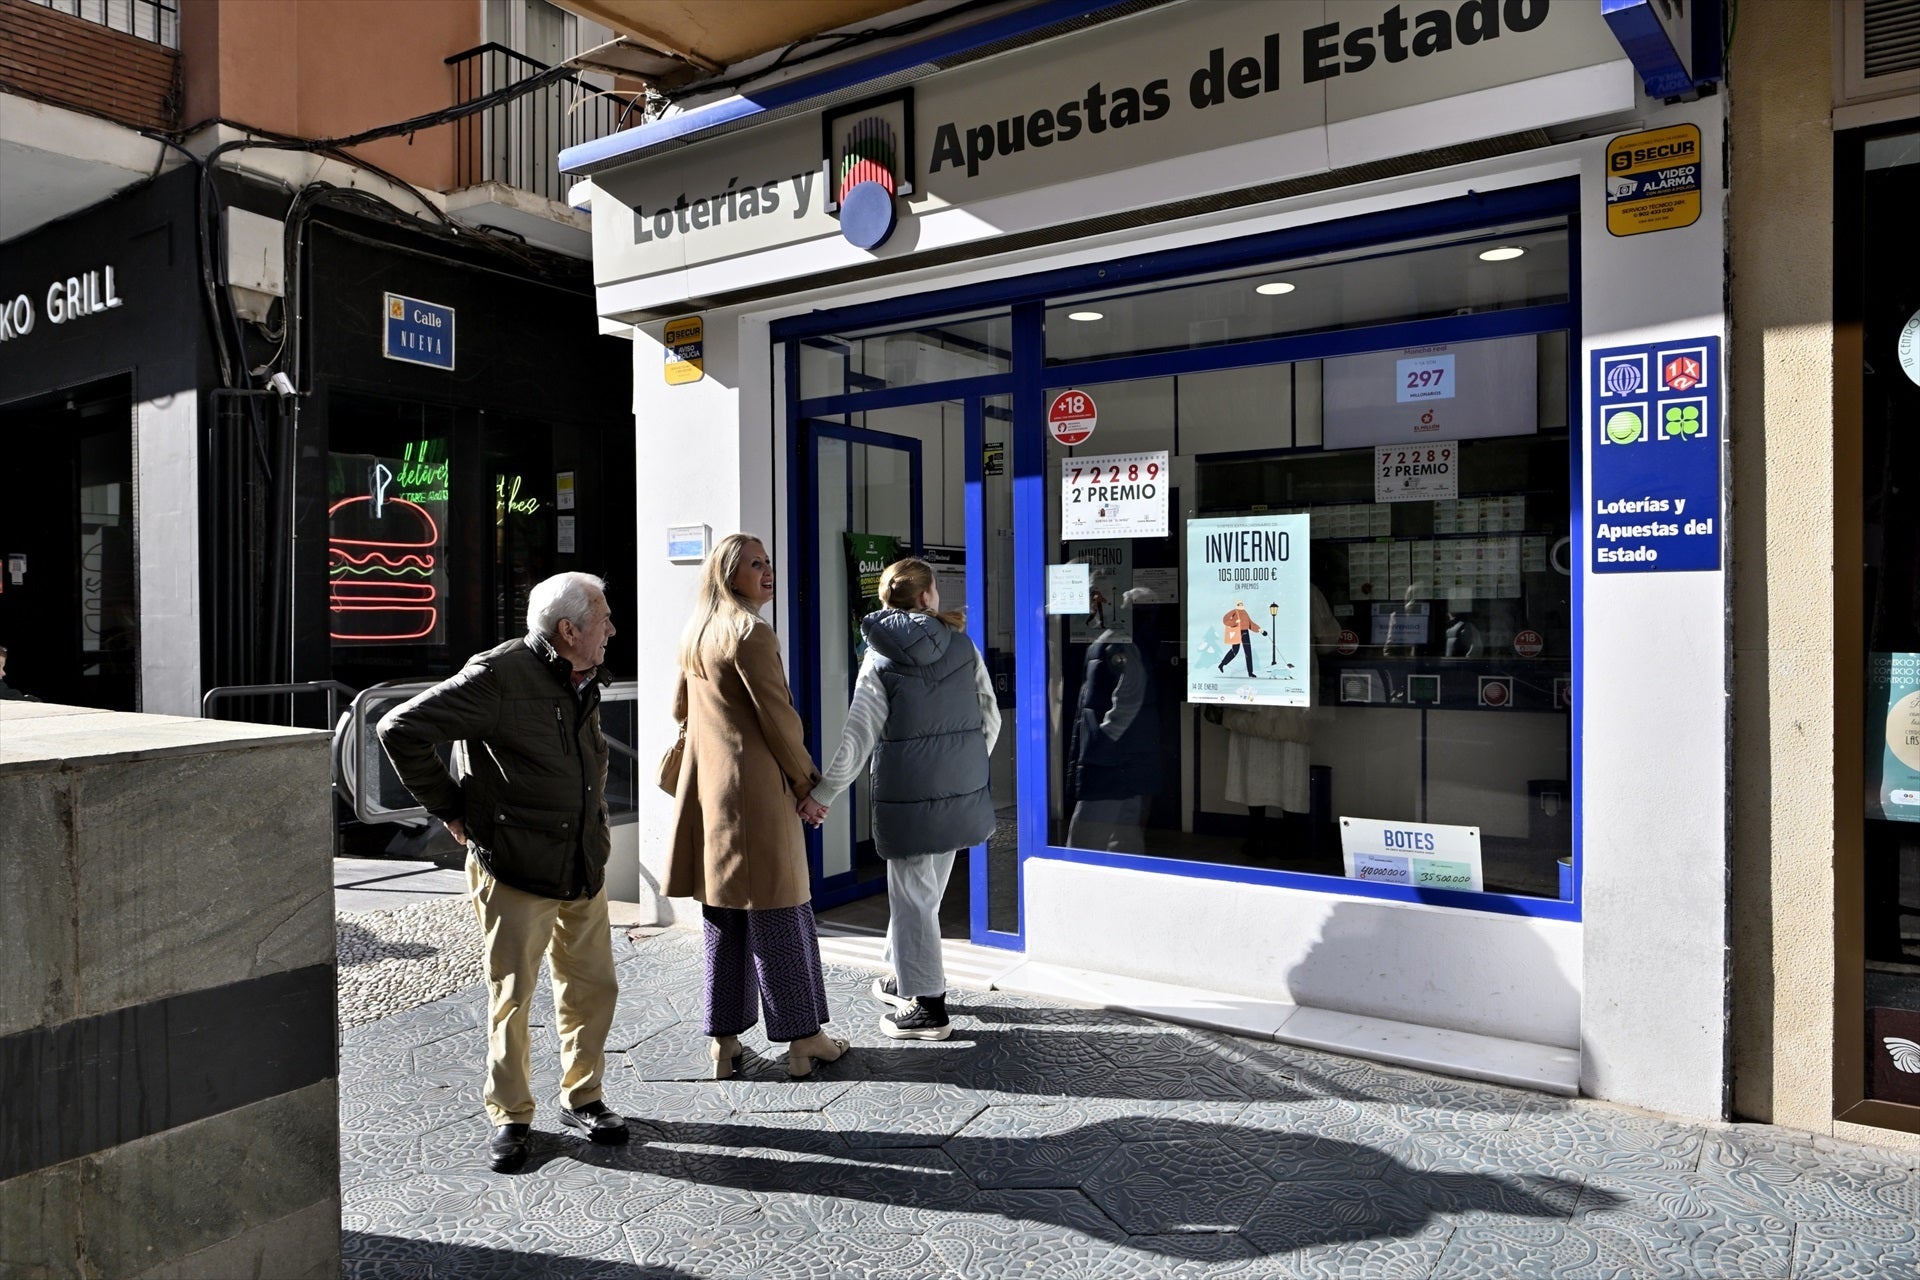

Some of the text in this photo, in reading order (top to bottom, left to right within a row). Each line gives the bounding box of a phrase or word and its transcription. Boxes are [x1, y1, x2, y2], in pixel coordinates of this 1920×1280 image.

[632, 0, 1550, 245] Loterías y Apuestas del Estado
[1633, 140, 1695, 162] SECUR
[1657, 165, 1695, 180] VIDEO
[1642, 175, 1695, 192] ALARMA
[47, 264, 122, 324] GRILL
[413, 309, 442, 328] Calle
[676, 327, 700, 338] SECUR
[1900, 318, 1920, 355] CENTRO
[401, 330, 442, 355] NUEVA
[1407, 369, 1444, 388] 297
[1059, 396, 1084, 414] +18
[1395, 463, 1449, 477] PREMIO
[1088, 483, 1156, 502] PREMIO
[1597, 496, 1686, 515] Loterías y
[1597, 518, 1713, 542] Apuestas del
[1206, 530, 1290, 563] INVIERNO
[1597, 545, 1658, 563] Estado
[859, 556, 885, 573] OJALÁ
[1079, 547, 1123, 566] INVIERNO
[1218, 567, 1278, 582] 105.000.000 €
[1235, 582, 1260, 591] EN PREMIOS
[1198, 682, 1203, 690] DE
[1204, 682, 1218, 691] ENERO
[1384, 829, 1435, 851] BOTES
